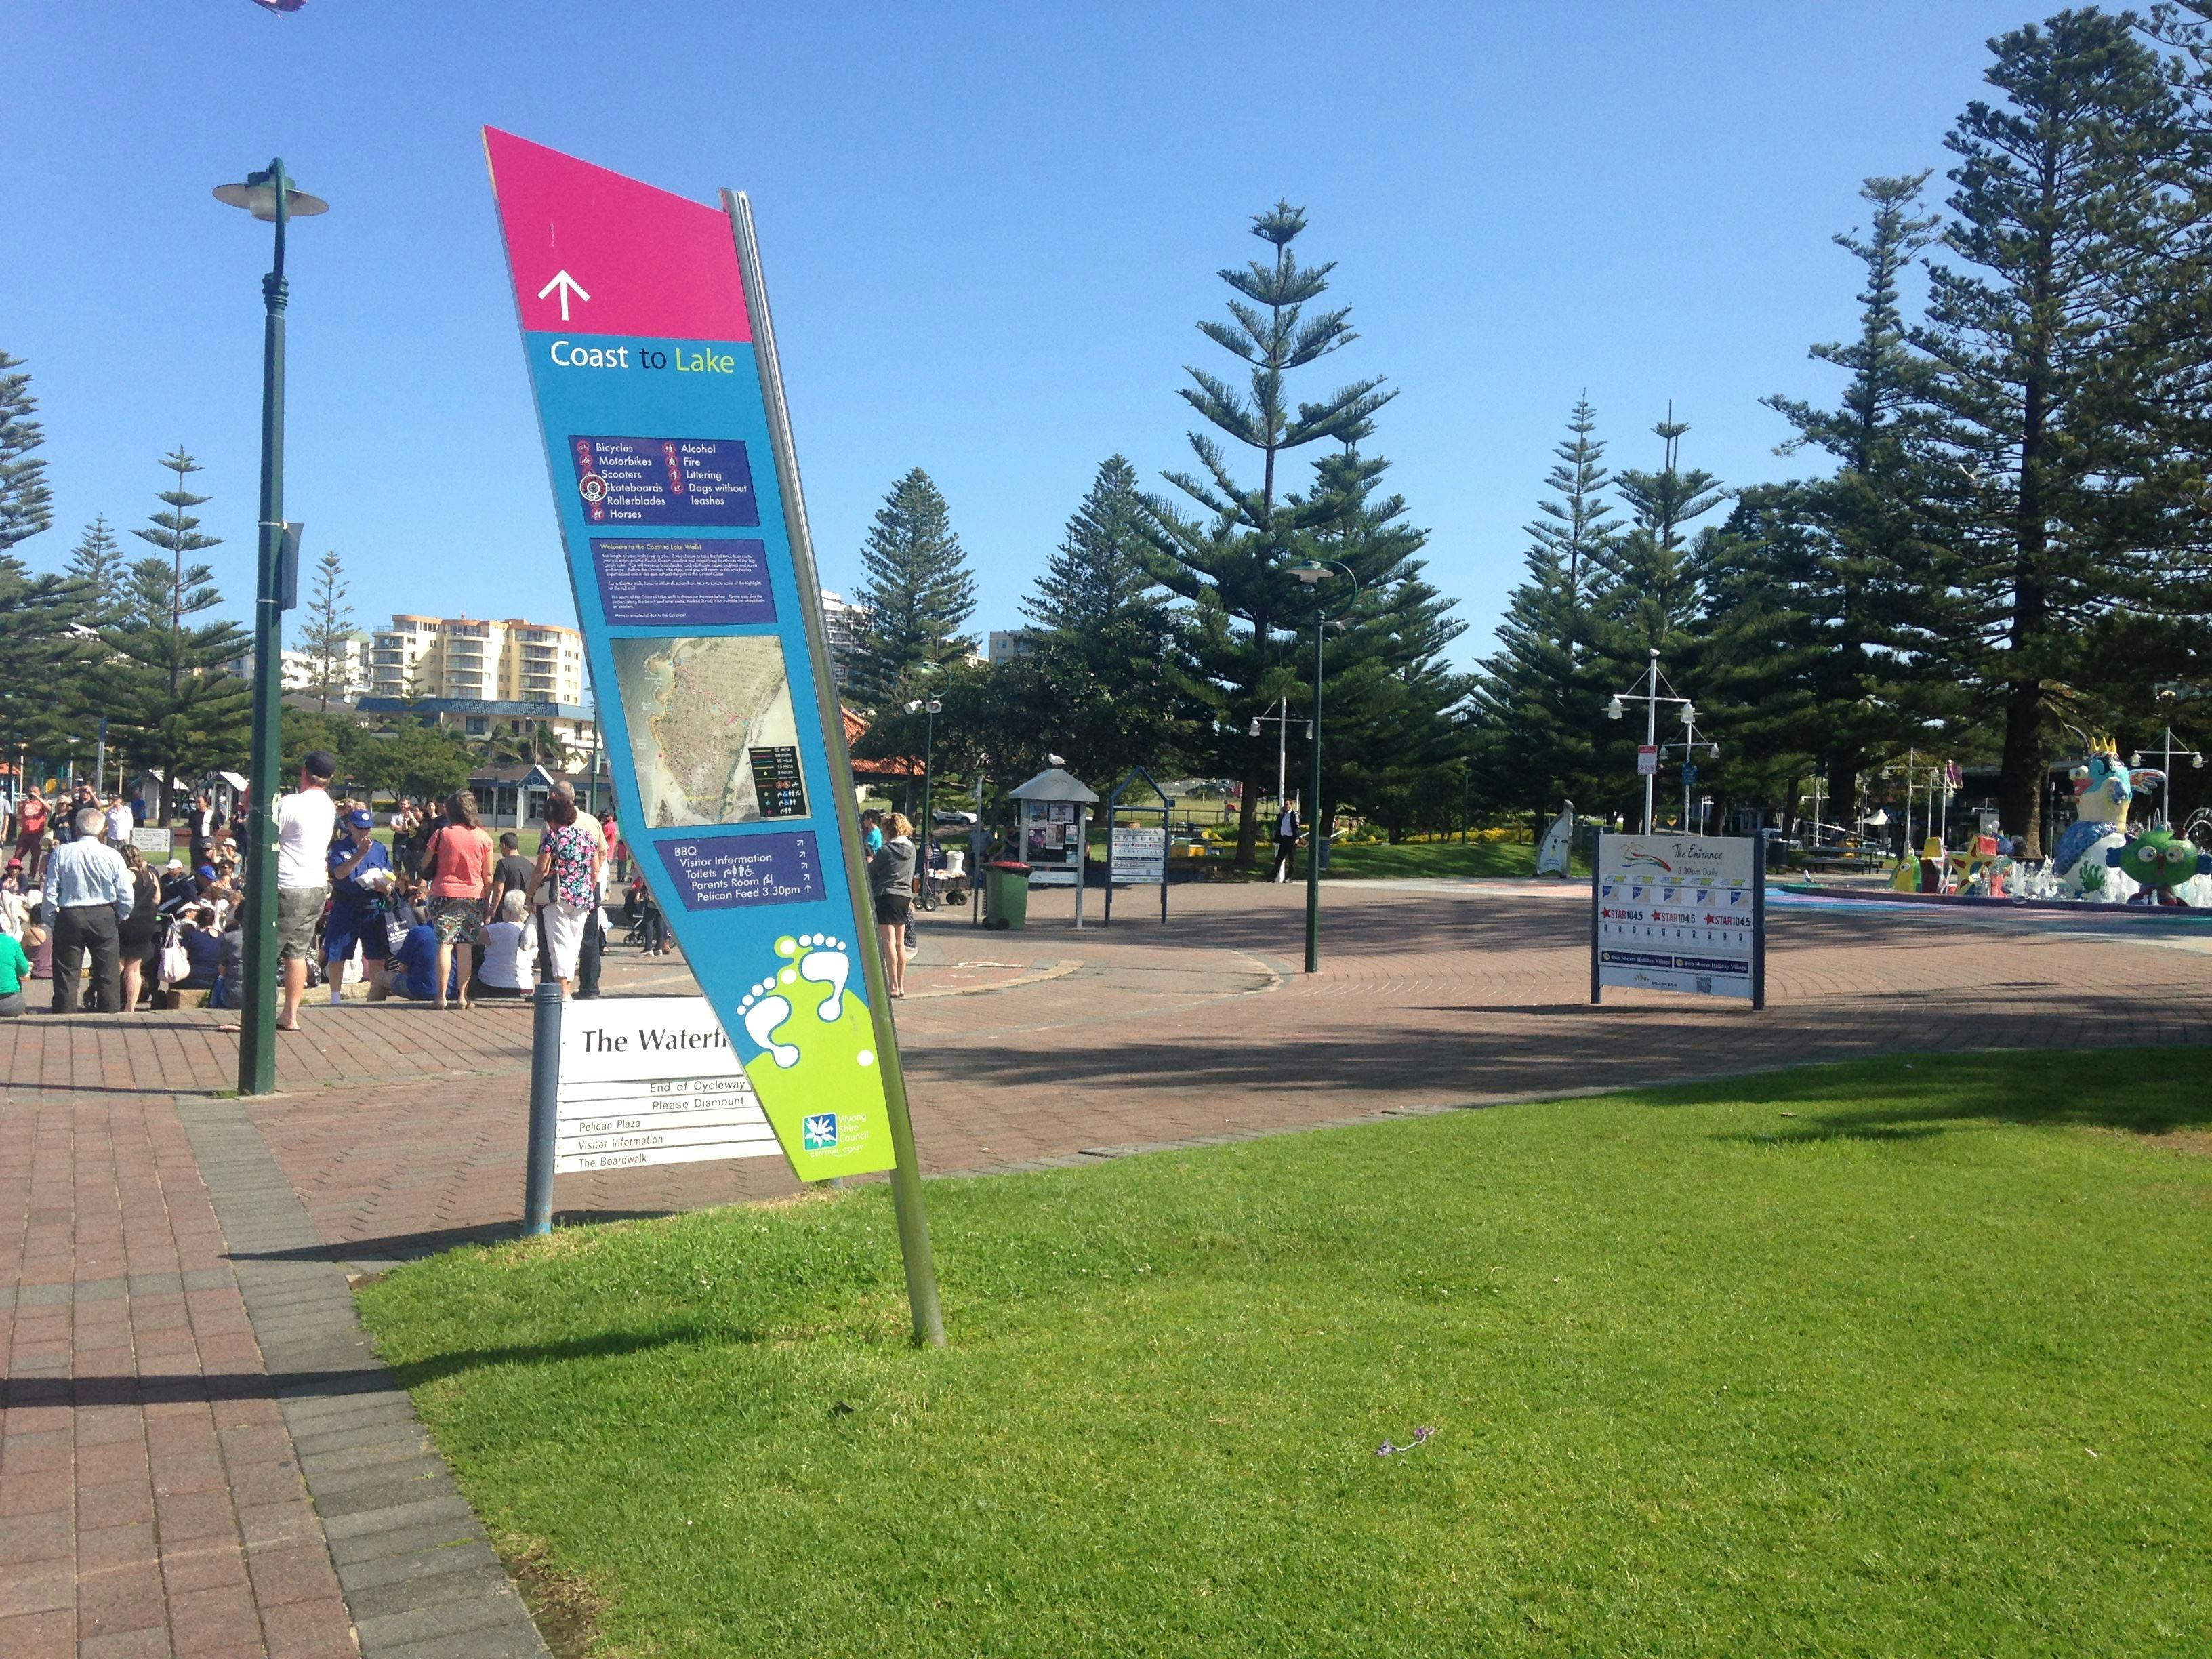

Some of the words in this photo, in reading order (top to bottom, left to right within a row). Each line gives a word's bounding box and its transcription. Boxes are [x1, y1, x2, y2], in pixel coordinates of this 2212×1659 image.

[550, 341, 628, 368] Coast
[640, 348, 667, 369] to
[676, 347, 735, 373] Lake
[596, 443, 633, 453] Bicycles
[681, 444, 716, 453] Alcohol
[599, 456, 652, 466] Motorbikes
[684, 457, 700, 466] Fire
[602, 470, 642, 479] Scooters
[687, 470, 722, 481] Littering
[606, 483, 663, 493] Skateboards
[689, 484, 712, 494] Dogs
[715, 484, 747, 493] without
[607, 496, 665, 506] Rollerblades
[691, 496, 724, 506] leashes
[610, 510, 642, 518] Horses
[675, 846, 697, 856] BBQ
[1672, 843, 1686, 859] The
[1687, 844, 1723, 859] Entrance
[680, 859, 712, 867] Visitor
[715, 855, 772, 865] Information
[686, 869, 716, 878] Toilets
[1702, 867, 1718, 876] Daily
[692, 881, 728, 890] Parents
[732, 878, 759, 886] Room
[697, 891, 732, 901] Pelican
[736, 889, 759, 898] Feed
[1611, 909, 1643, 920] STAR104.5
[1662, 912, 1696, 924] STAR104.5
[1715, 916, 1750, 927] STAR104.5
[582, 1029, 628, 1052] The
[650, 1083, 670, 1092] End
[677, 1081, 688, 1091] of
[694, 1080, 745, 1092] Cycleway
[653, 1101, 689, 1110] Please
[695, 1097, 744, 1107] Dismount
[838, 1114, 866, 1123] Wyong
[579, 1120, 612, 1132] Pelican
[617, 1120, 640, 1129] Plaza
[839, 1124, 859, 1132] Shire
[840, 1131, 869, 1142] Council
[579, 1139, 608, 1151] Visitor
[612, 1135, 663, 1147] Information
[579, 1158, 595, 1168] The
[600, 1154, 647, 1166] Boardwalk
